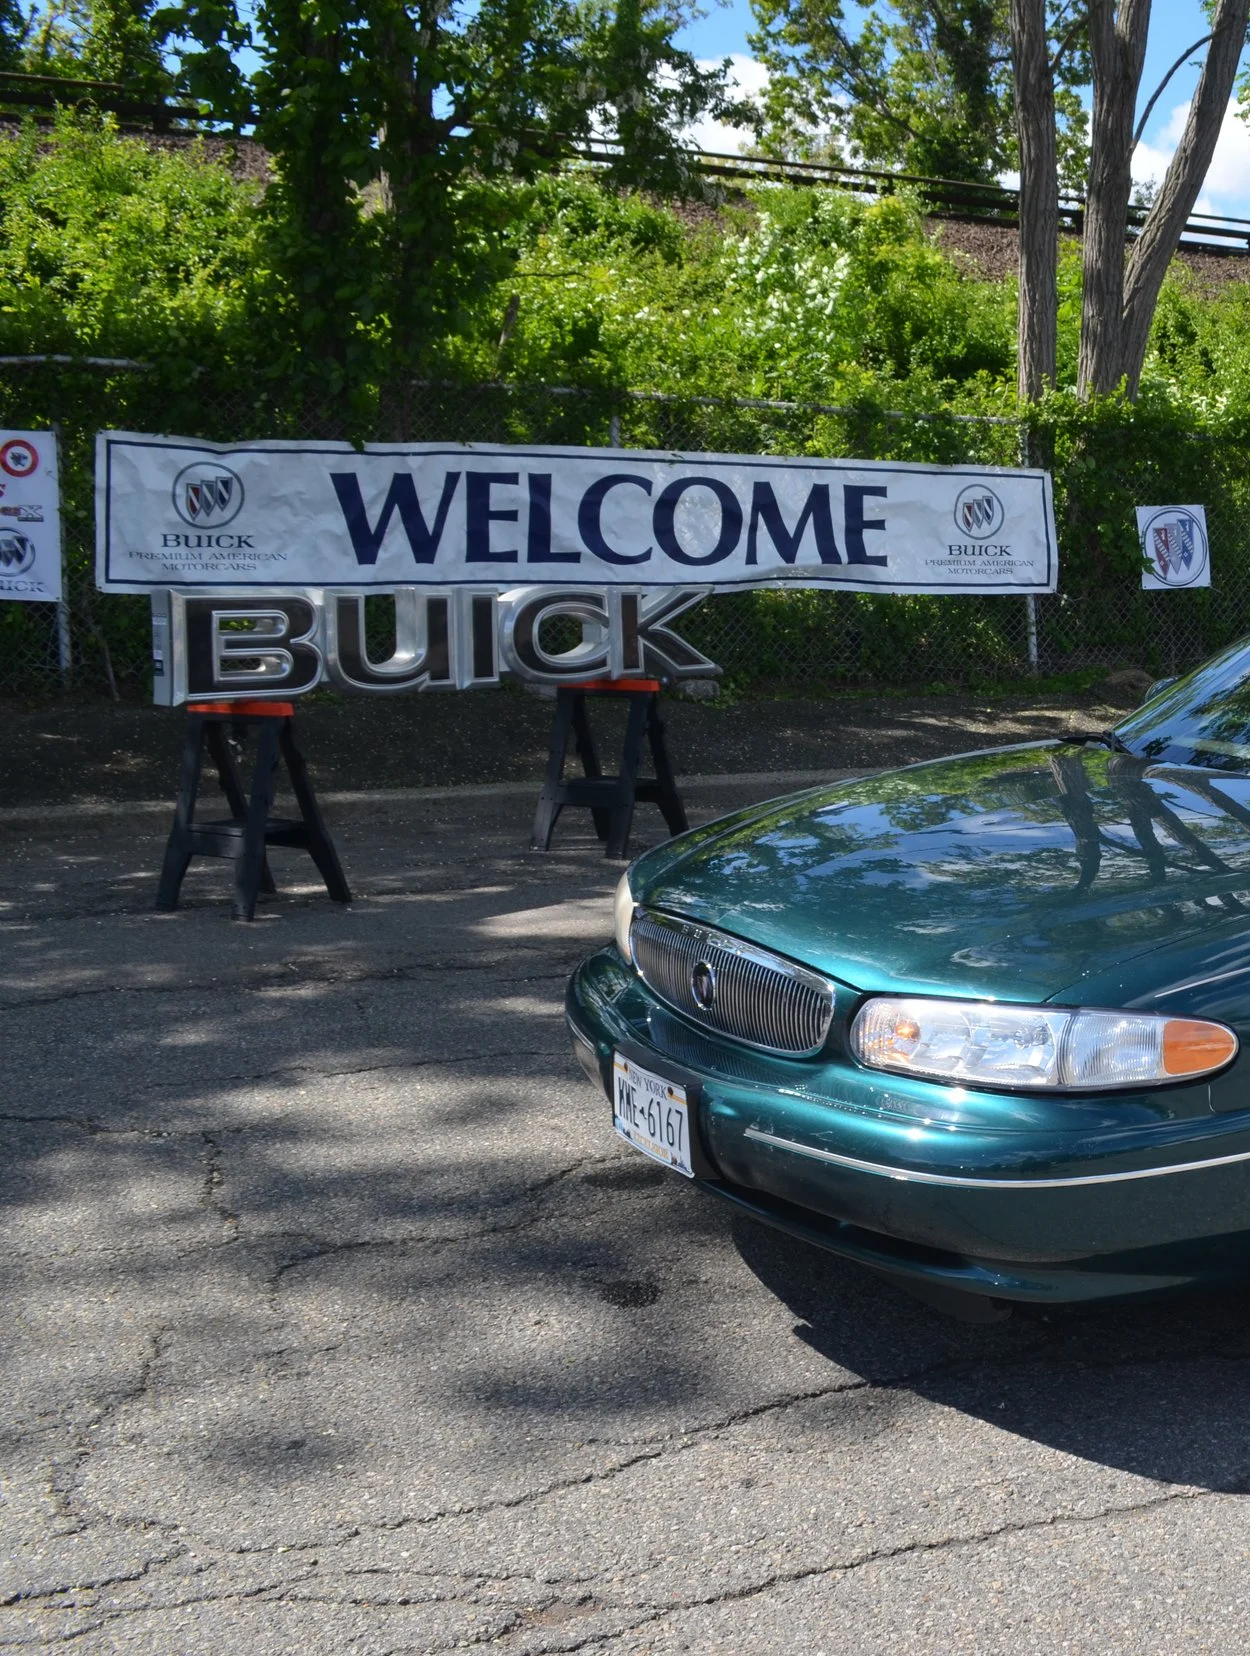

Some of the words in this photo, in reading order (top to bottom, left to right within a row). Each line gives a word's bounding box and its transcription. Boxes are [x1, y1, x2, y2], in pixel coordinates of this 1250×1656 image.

[329, 470, 888, 567] WELCOME
[160, 533, 255, 549] BUICK
[128, 551, 202, 561] PREMIUM
[208, 552, 288, 561] AMERICAN
[947, 545, 1013, 557] BUICK
[161, 562, 257, 571] MOTORCARS
[947, 567, 1014, 575] MOTORCARS
[155, 586, 722, 706] BUICK
[643, 1078, 668, 1100] YORK
